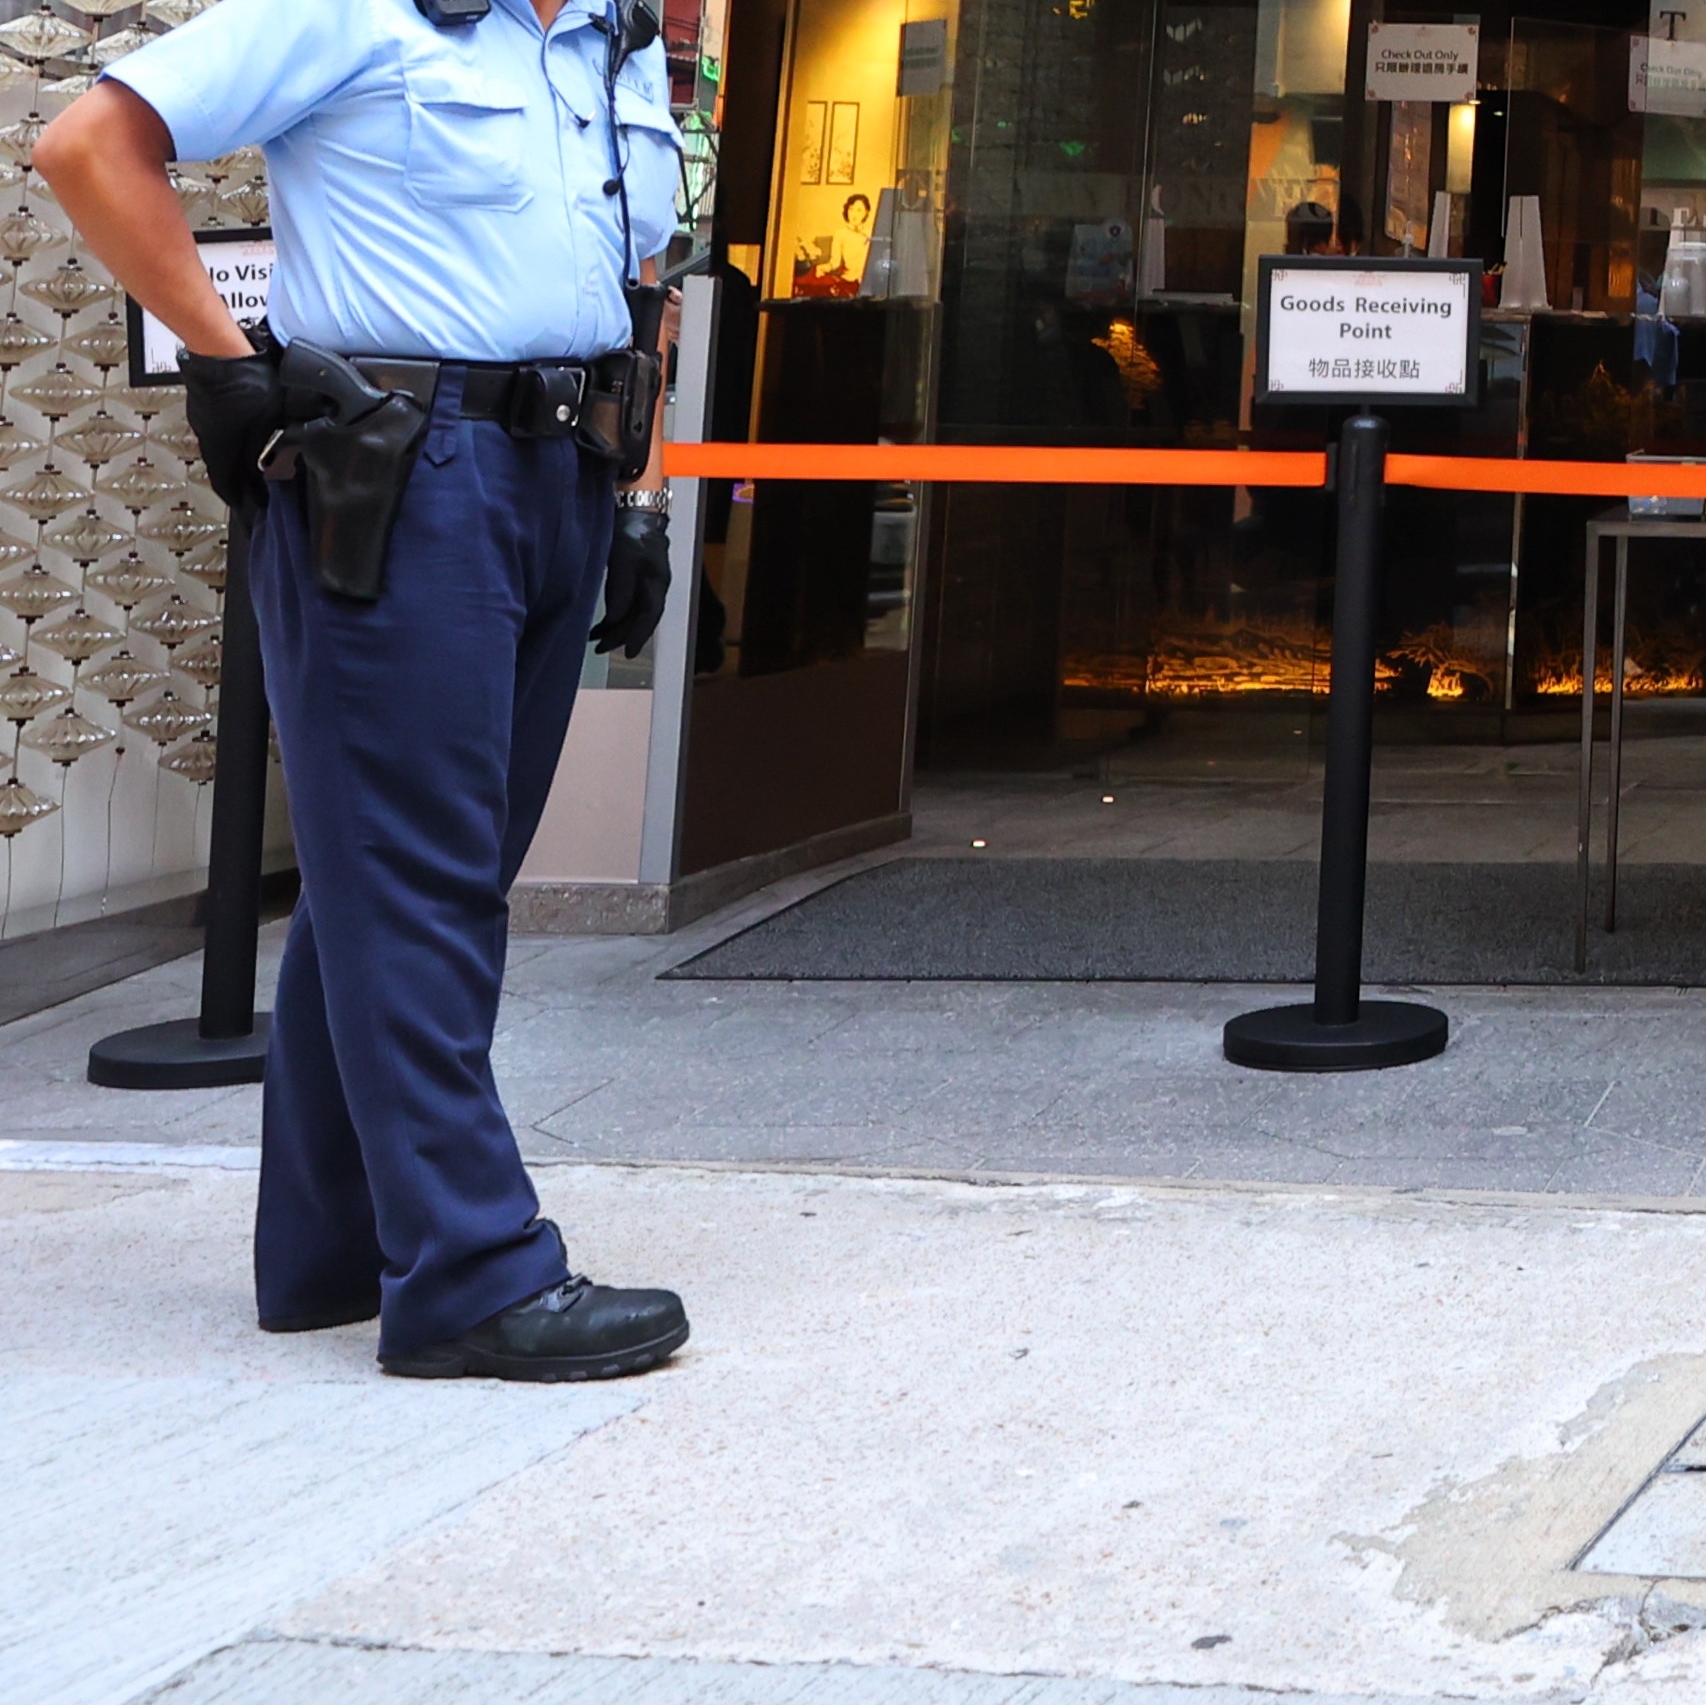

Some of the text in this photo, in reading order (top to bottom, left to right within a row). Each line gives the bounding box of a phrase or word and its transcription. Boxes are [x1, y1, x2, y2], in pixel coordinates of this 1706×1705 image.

[1381, 48, 1459, 62] Check Out Only
[235, 263, 274, 282] Visi
[1280, 295, 1452, 318] Goods Receiving
[1339, 322, 1392, 339] Point
[1309, 358, 1420, 379] 物品接收點
